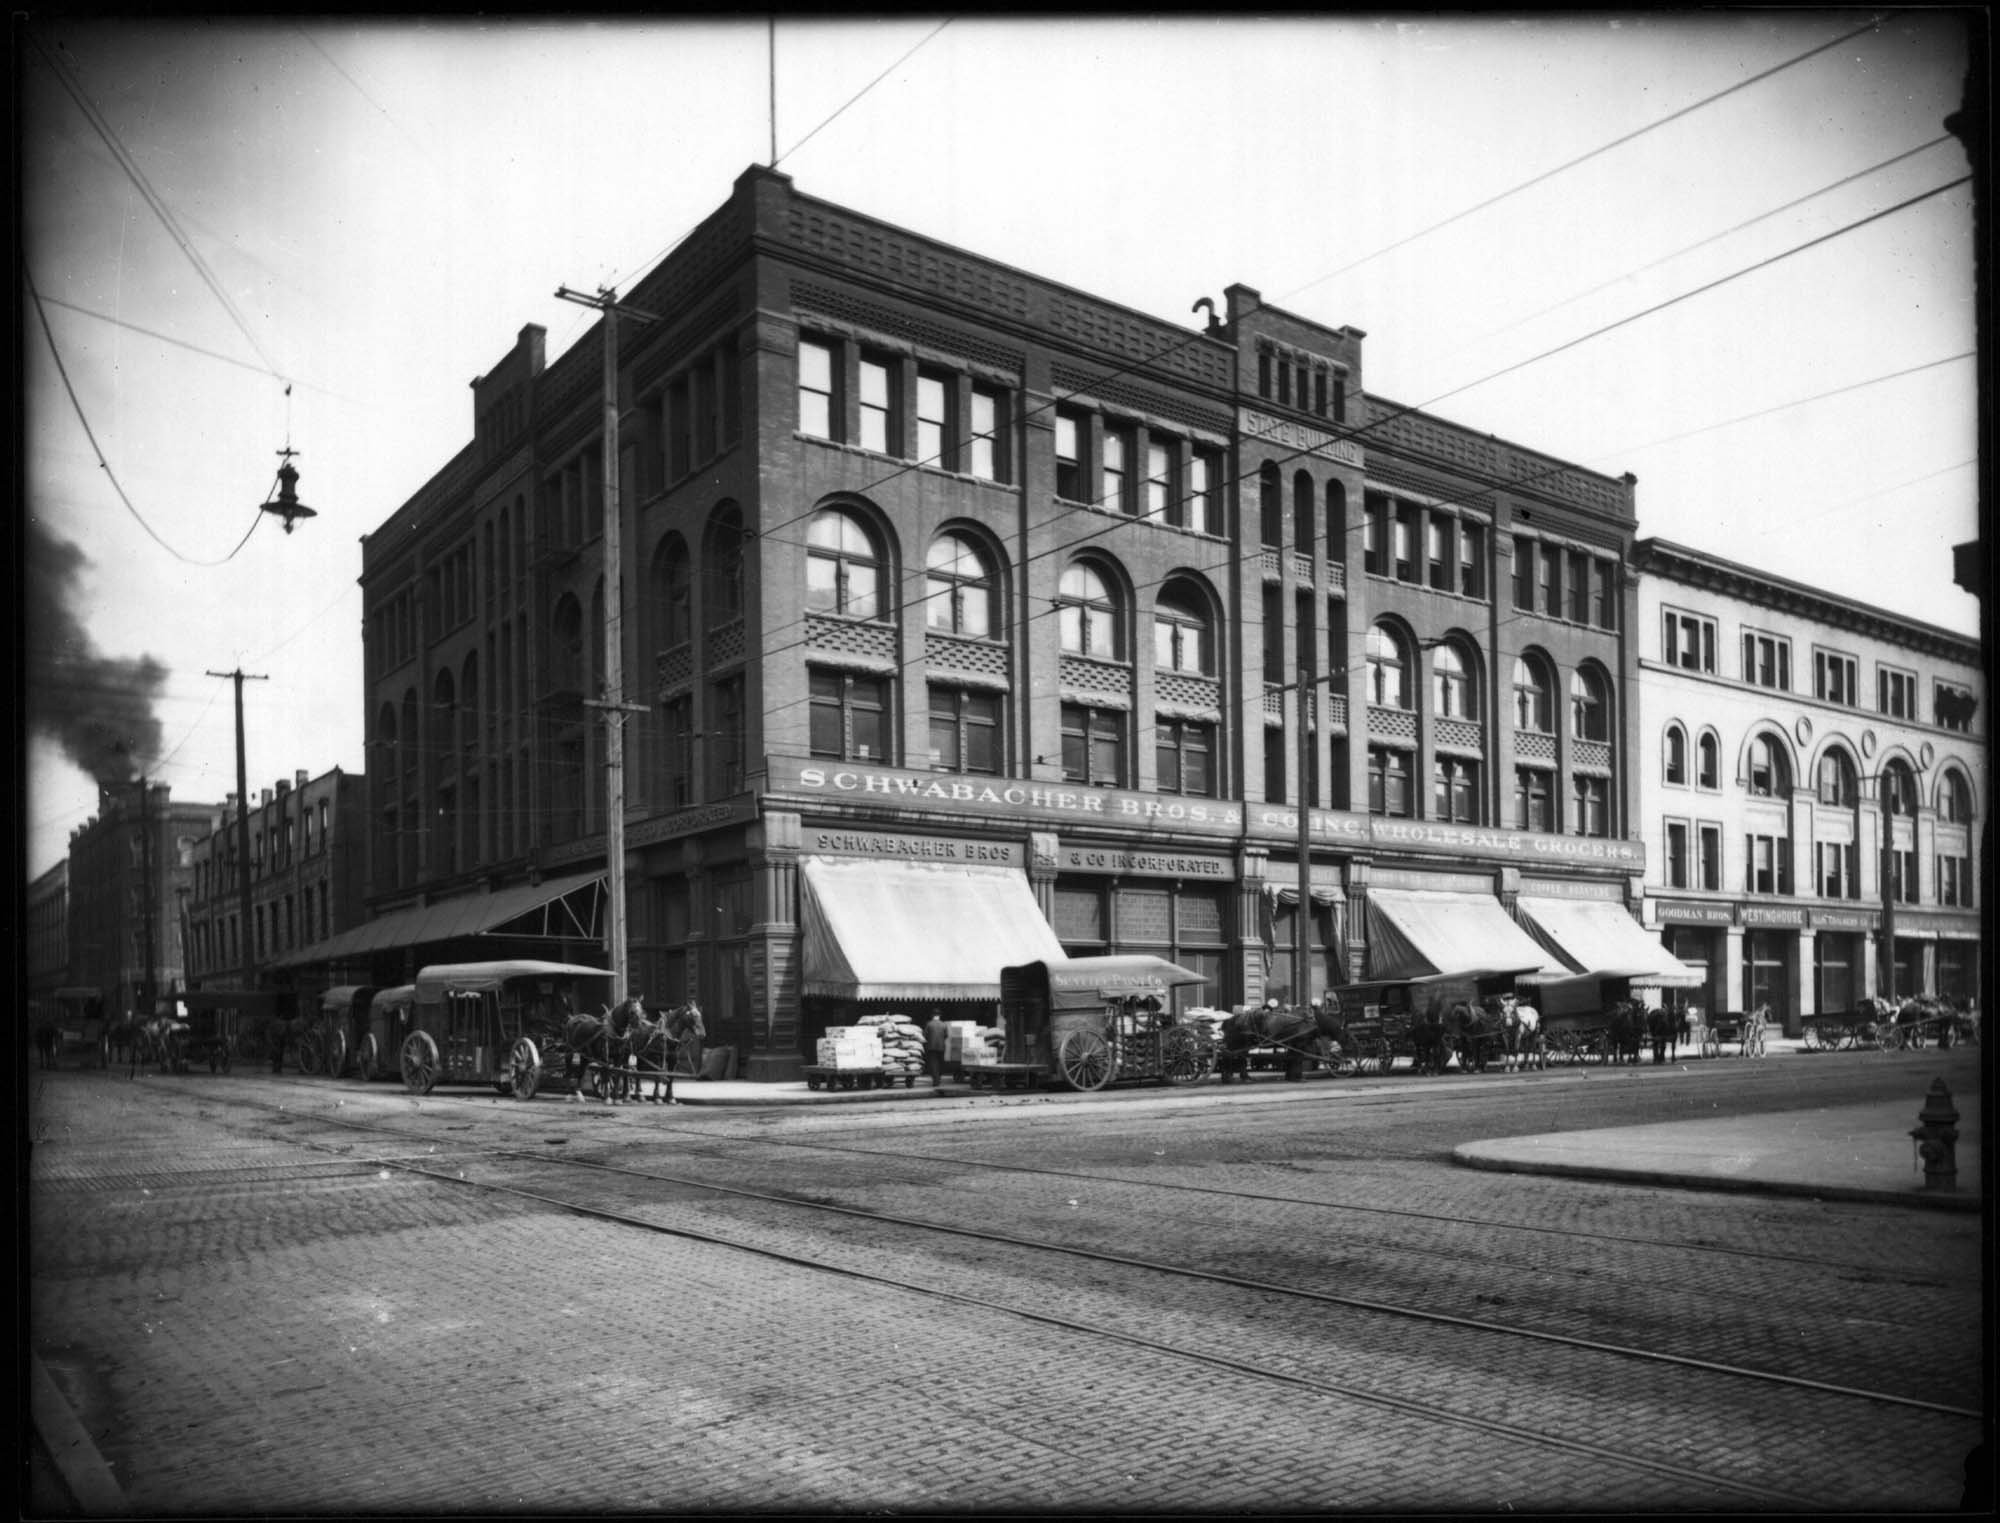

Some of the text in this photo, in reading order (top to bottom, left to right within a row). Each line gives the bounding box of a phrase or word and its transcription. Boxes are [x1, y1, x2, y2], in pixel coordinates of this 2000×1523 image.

[799, 768, 1103, 813] SCHWABACHER
[1121, 798, 1215, 825] BROS.
[1223, 808, 1241, 825] &
[1371, 822, 1521, 852] WHOLESALE
[816, 832, 1010, 861] SCHWABACHER BROS
[1111, 853, 1225, 875] INCORPORATED.
[1658, 907, 1703, 919] GOODMAN
[1740, 908, 1803, 924] WESTINGHOUSE
